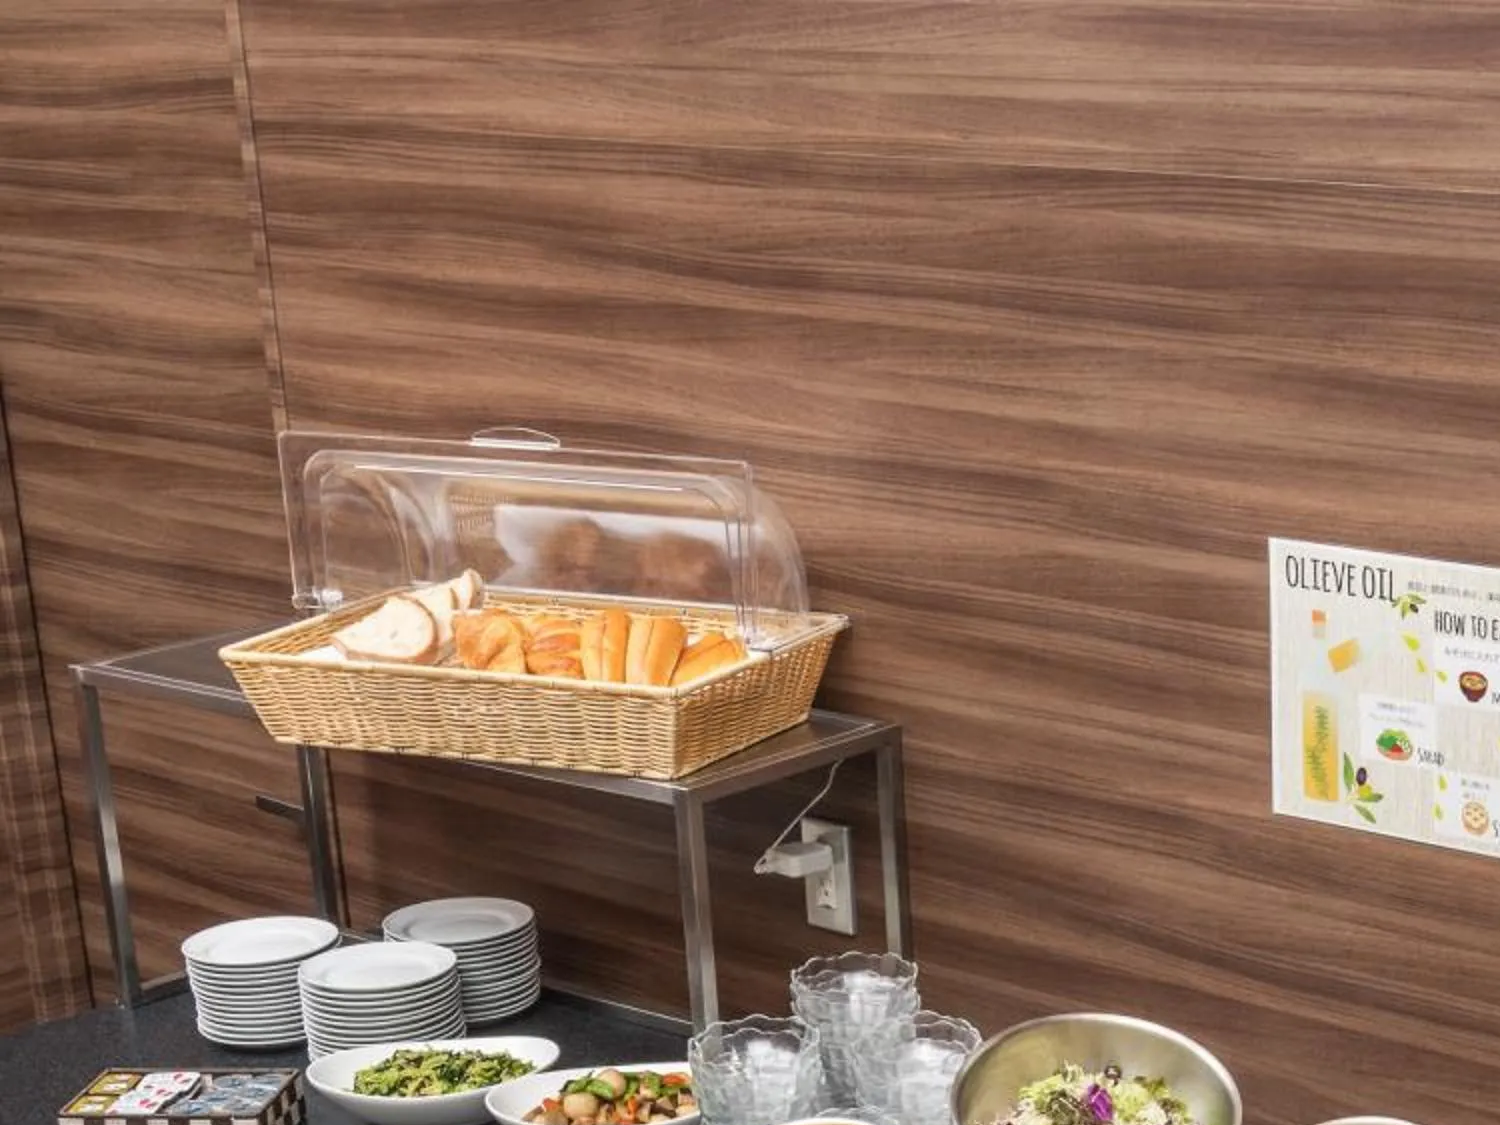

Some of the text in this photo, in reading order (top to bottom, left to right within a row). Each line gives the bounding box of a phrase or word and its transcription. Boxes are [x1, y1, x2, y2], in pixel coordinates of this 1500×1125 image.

[1285, 555, 1356, 597] OLIEVE
[1361, 565, 1397, 602] OIL
[1434, 610, 1466, 637] HOW
[1471, 615, 1488, 640] TO
